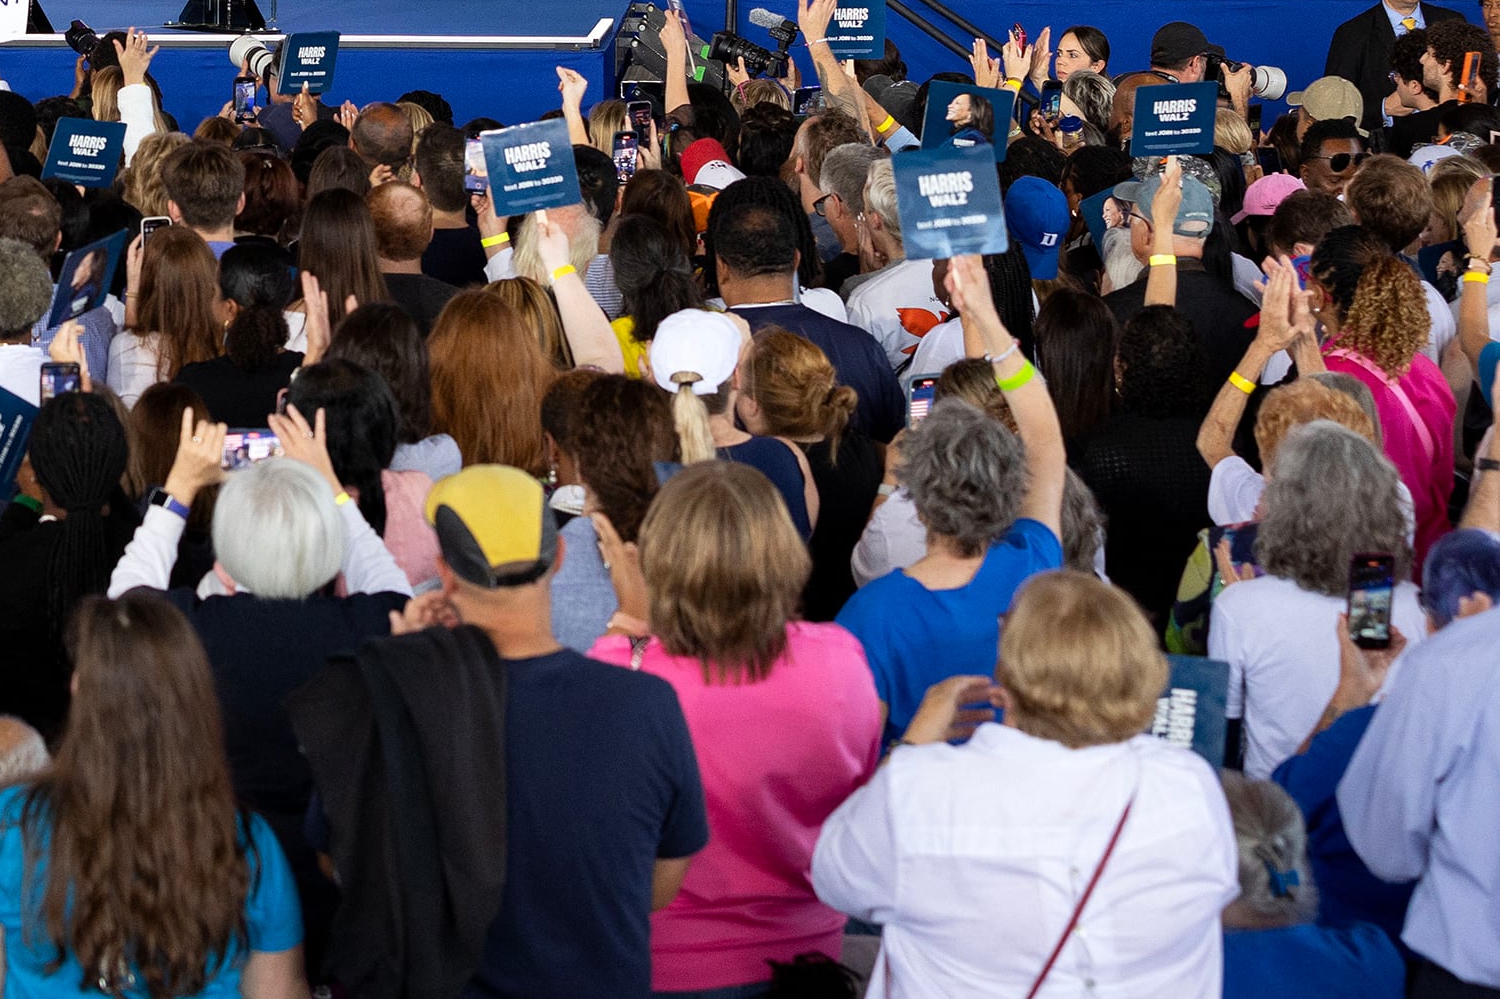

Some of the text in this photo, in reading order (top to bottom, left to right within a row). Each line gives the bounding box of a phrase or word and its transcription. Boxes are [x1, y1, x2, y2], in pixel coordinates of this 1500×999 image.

[834, 8, 869, 21] HARRIS
[838, 20, 864, 28] WALZ
[1153, 99, 1197, 115] HARRIS
[1159, 112, 1190, 122] WALZ
[504, 141, 551, 165] HARRIS
[513, 158, 547, 173] WALZ
